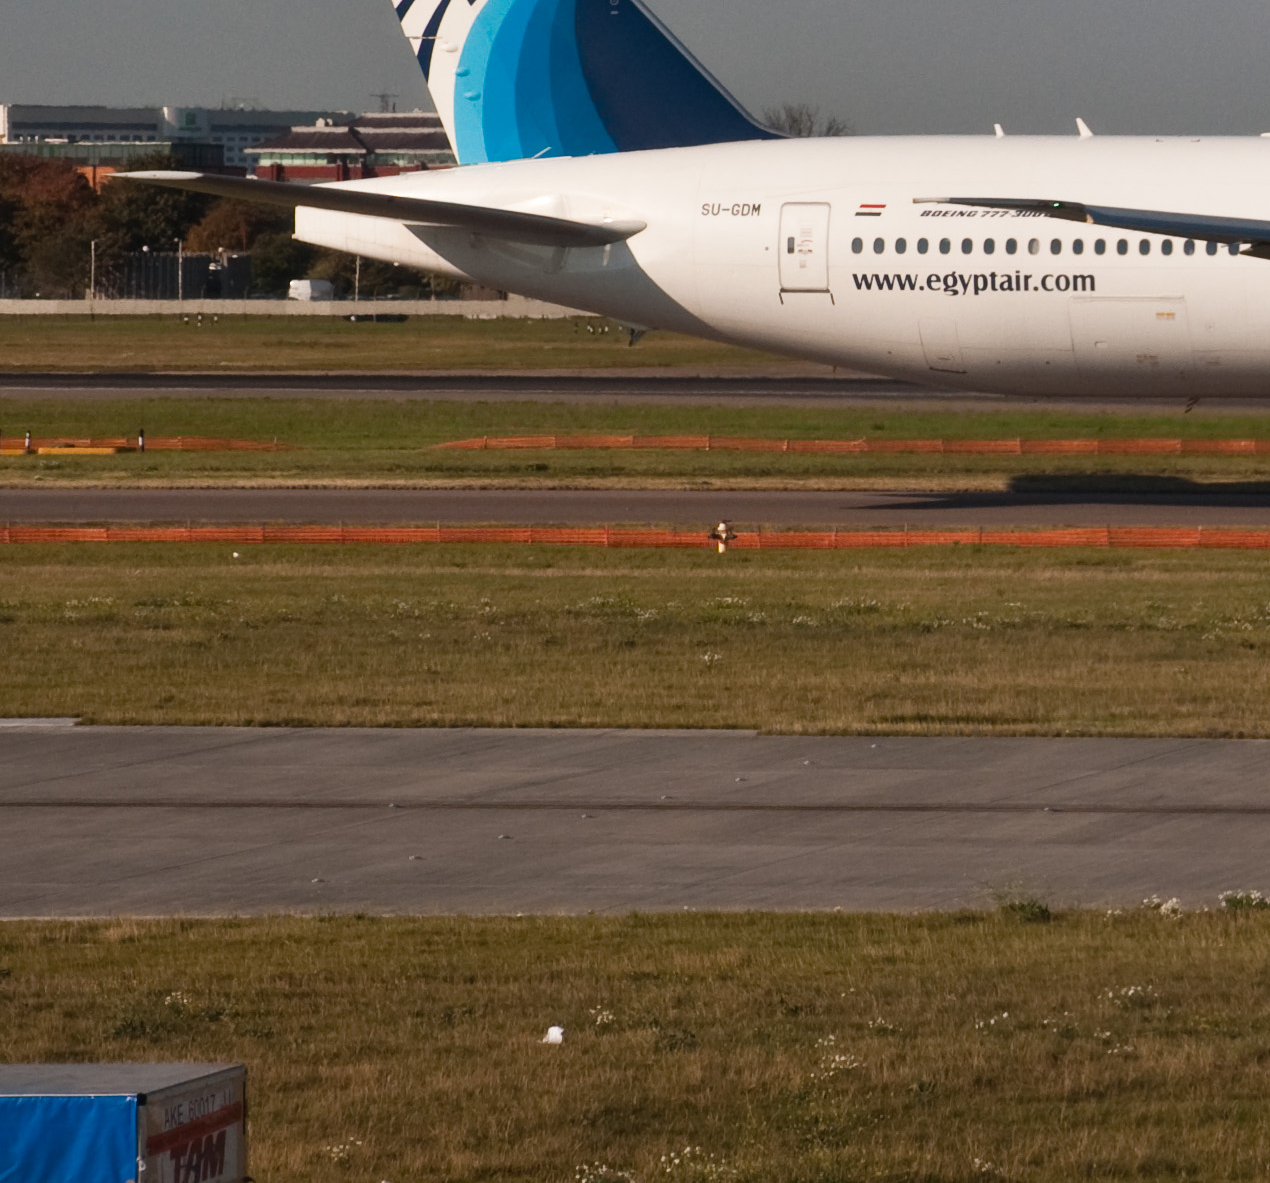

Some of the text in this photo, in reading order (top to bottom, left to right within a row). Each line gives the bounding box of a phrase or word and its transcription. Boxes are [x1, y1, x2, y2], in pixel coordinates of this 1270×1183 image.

[701, 203, 762, 217] SU-GDM
[920, 209, 979, 218] BOEING
[852, 270, 1096, 296] www.egyptair.com
[164, 1103, 184, 1130] AKE
